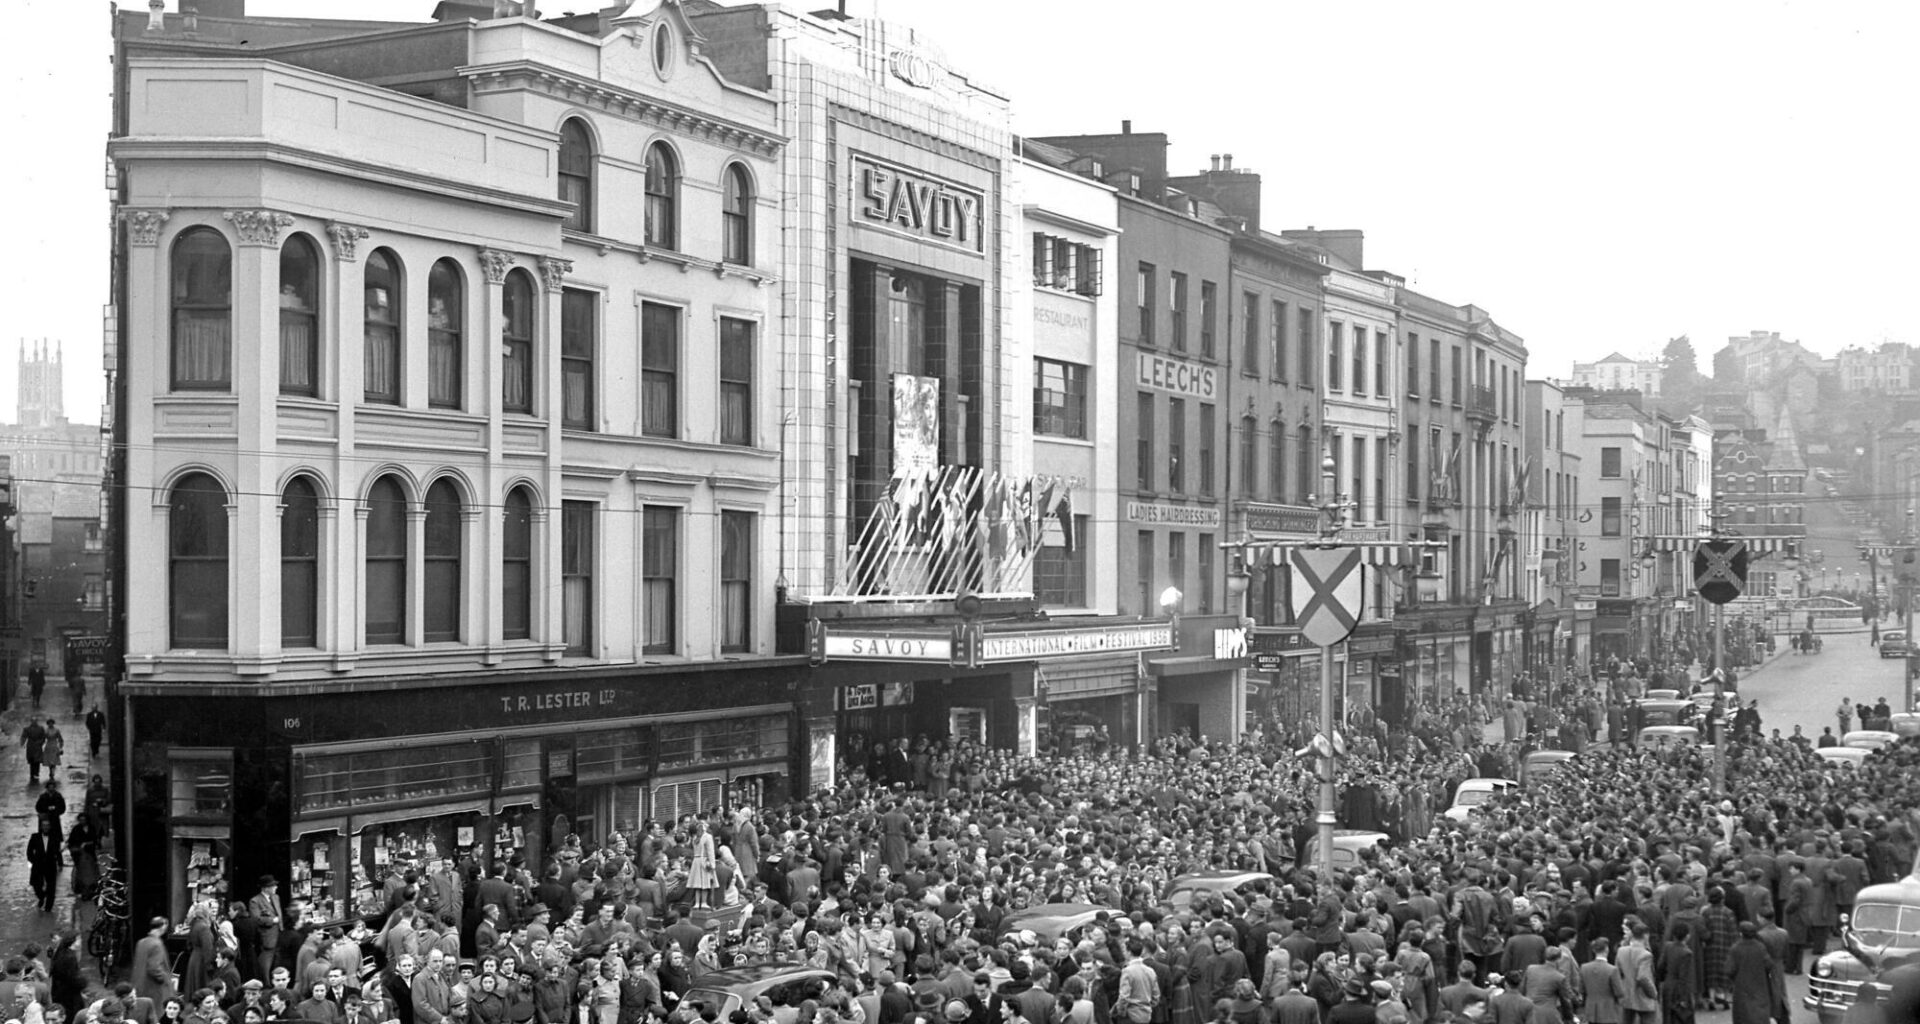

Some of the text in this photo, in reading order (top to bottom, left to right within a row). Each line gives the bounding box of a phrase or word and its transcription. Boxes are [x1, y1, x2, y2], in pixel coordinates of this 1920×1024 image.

[866, 168, 977, 242] SAVOY
[1033, 306, 1088, 330] RESTAURANT
[1140, 354, 1214, 397] LEECH'S
[1129, 503, 1219, 526] LADIES HAIRDRESSING
[851, 638, 928, 656] SAVOY
[985, 628, 1168, 657] INTERNATIONAL FILM FESTIVAL 1956
[501, 695, 512, 713] T.
[518, 695, 531, 712] R.
[536, 691, 591, 710] LESTER
[283, 717, 301, 730] 106
